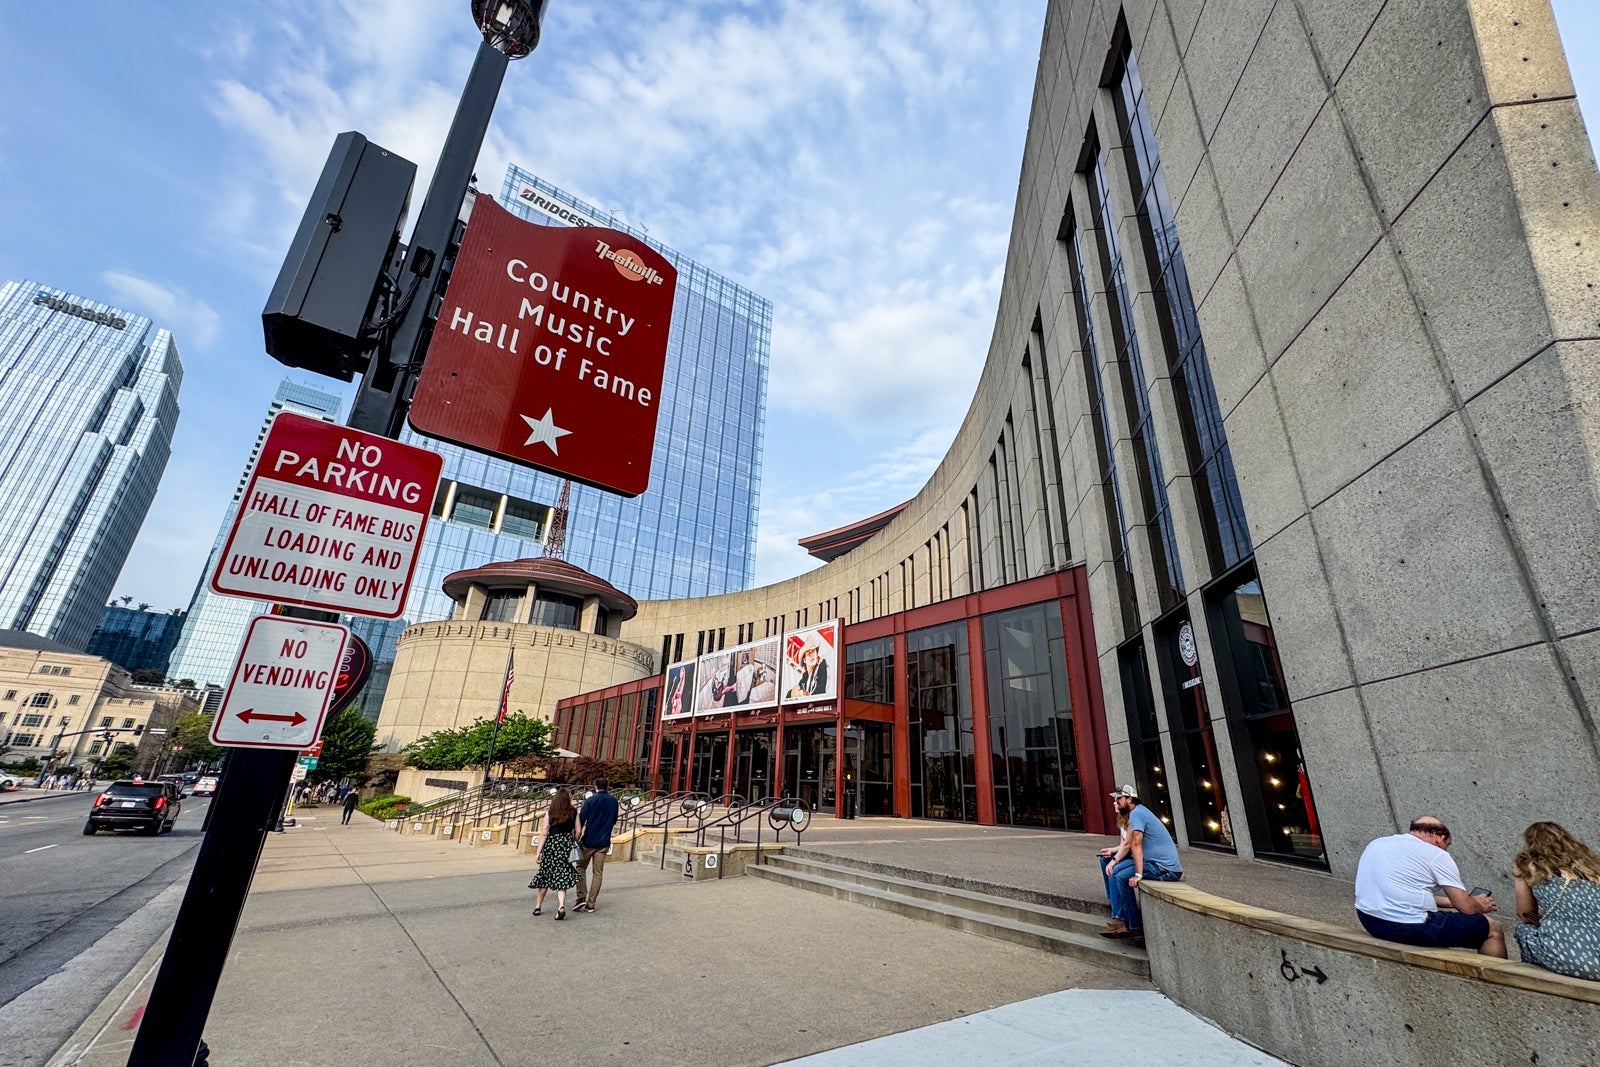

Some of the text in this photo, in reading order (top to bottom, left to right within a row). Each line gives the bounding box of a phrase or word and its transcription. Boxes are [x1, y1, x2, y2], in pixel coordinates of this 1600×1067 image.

[595, 239, 664, 286] Nashville
[506, 258, 635, 337] Country
[518, 298, 612, 356] Music
[450, 306, 652, 407] Hall of Fame
[336, 438, 382, 467] NO
[274, 449, 422, 504] PARKING
[250, 491, 415, 543] HALL OF FAME BUS
[264, 527, 402, 570] LOADING AND
[229, 554, 404, 601] UNLOADING ONLY
[280, 638, 308, 659] NO
[242, 663, 329, 690] VENDING
